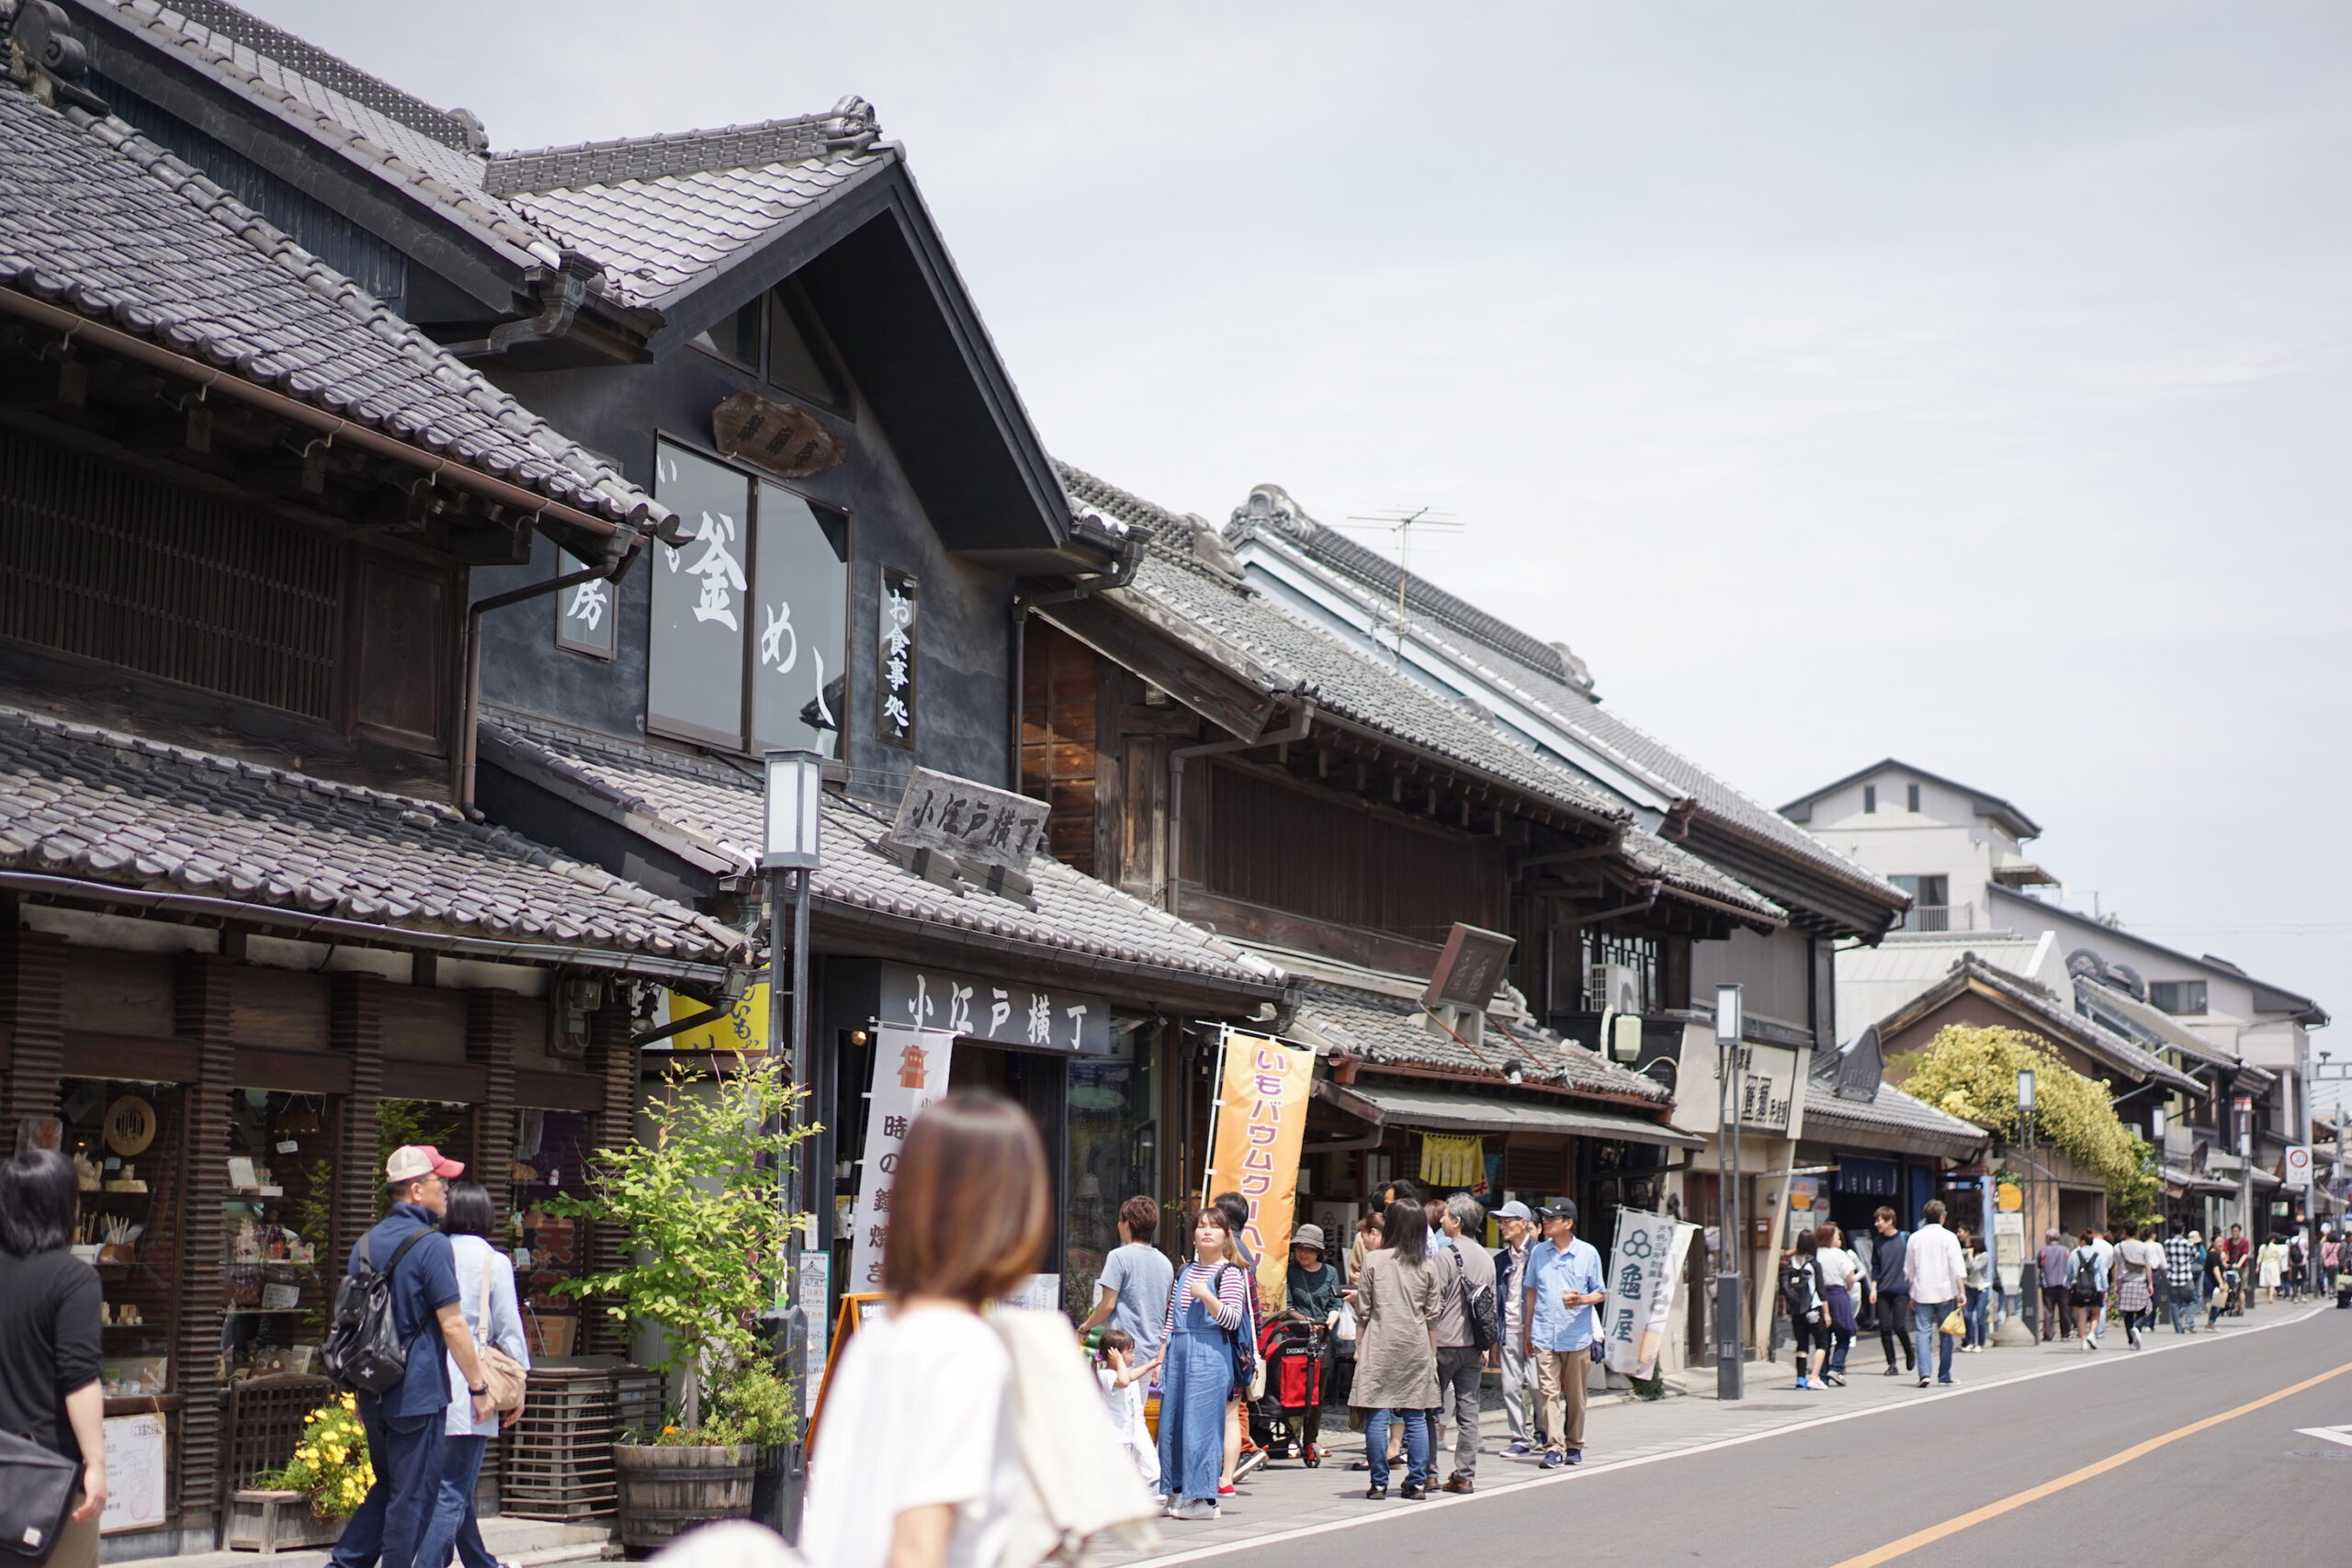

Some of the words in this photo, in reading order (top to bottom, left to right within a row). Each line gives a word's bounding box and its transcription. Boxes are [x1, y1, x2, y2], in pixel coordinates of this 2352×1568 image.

[884, 588, 910, 728] お食事処
[911, 789, 1039, 854] 小江戸横丁
[908, 974, 1088, 1050] 小江戸横丁
